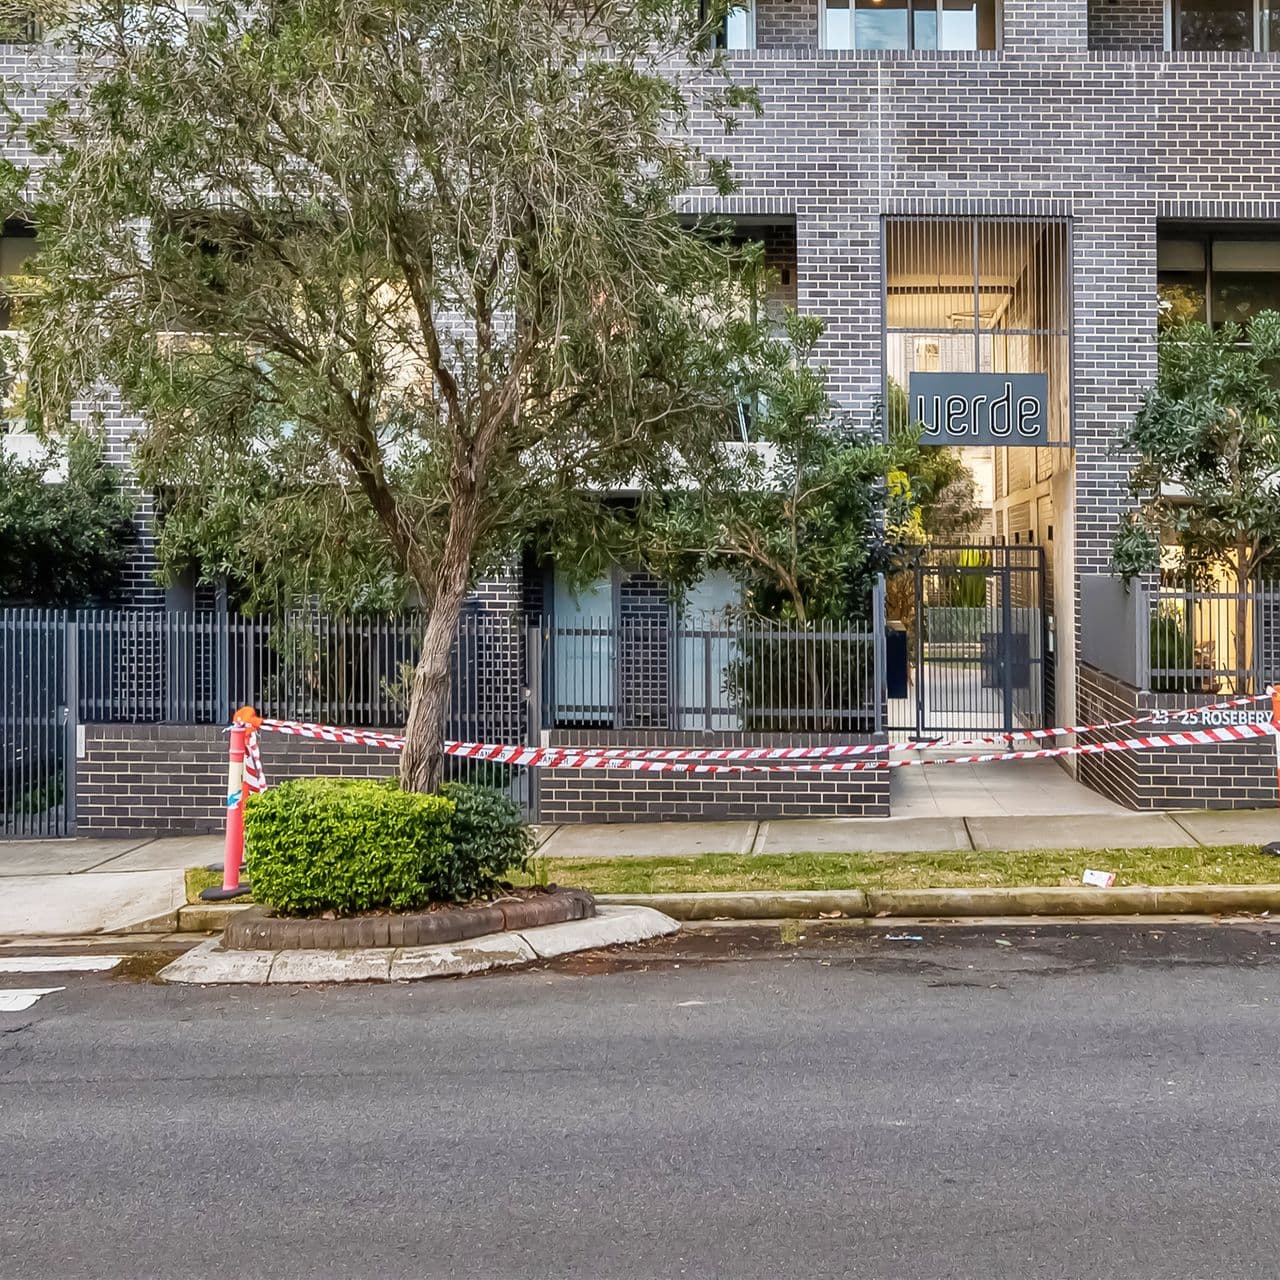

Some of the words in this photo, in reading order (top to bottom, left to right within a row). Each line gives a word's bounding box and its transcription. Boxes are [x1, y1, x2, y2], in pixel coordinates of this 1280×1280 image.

[917, 381, 1040, 437] verde
[1181, 711, 1198, 725] 25
[1202, 710, 1273, 726] ROSEBERY
